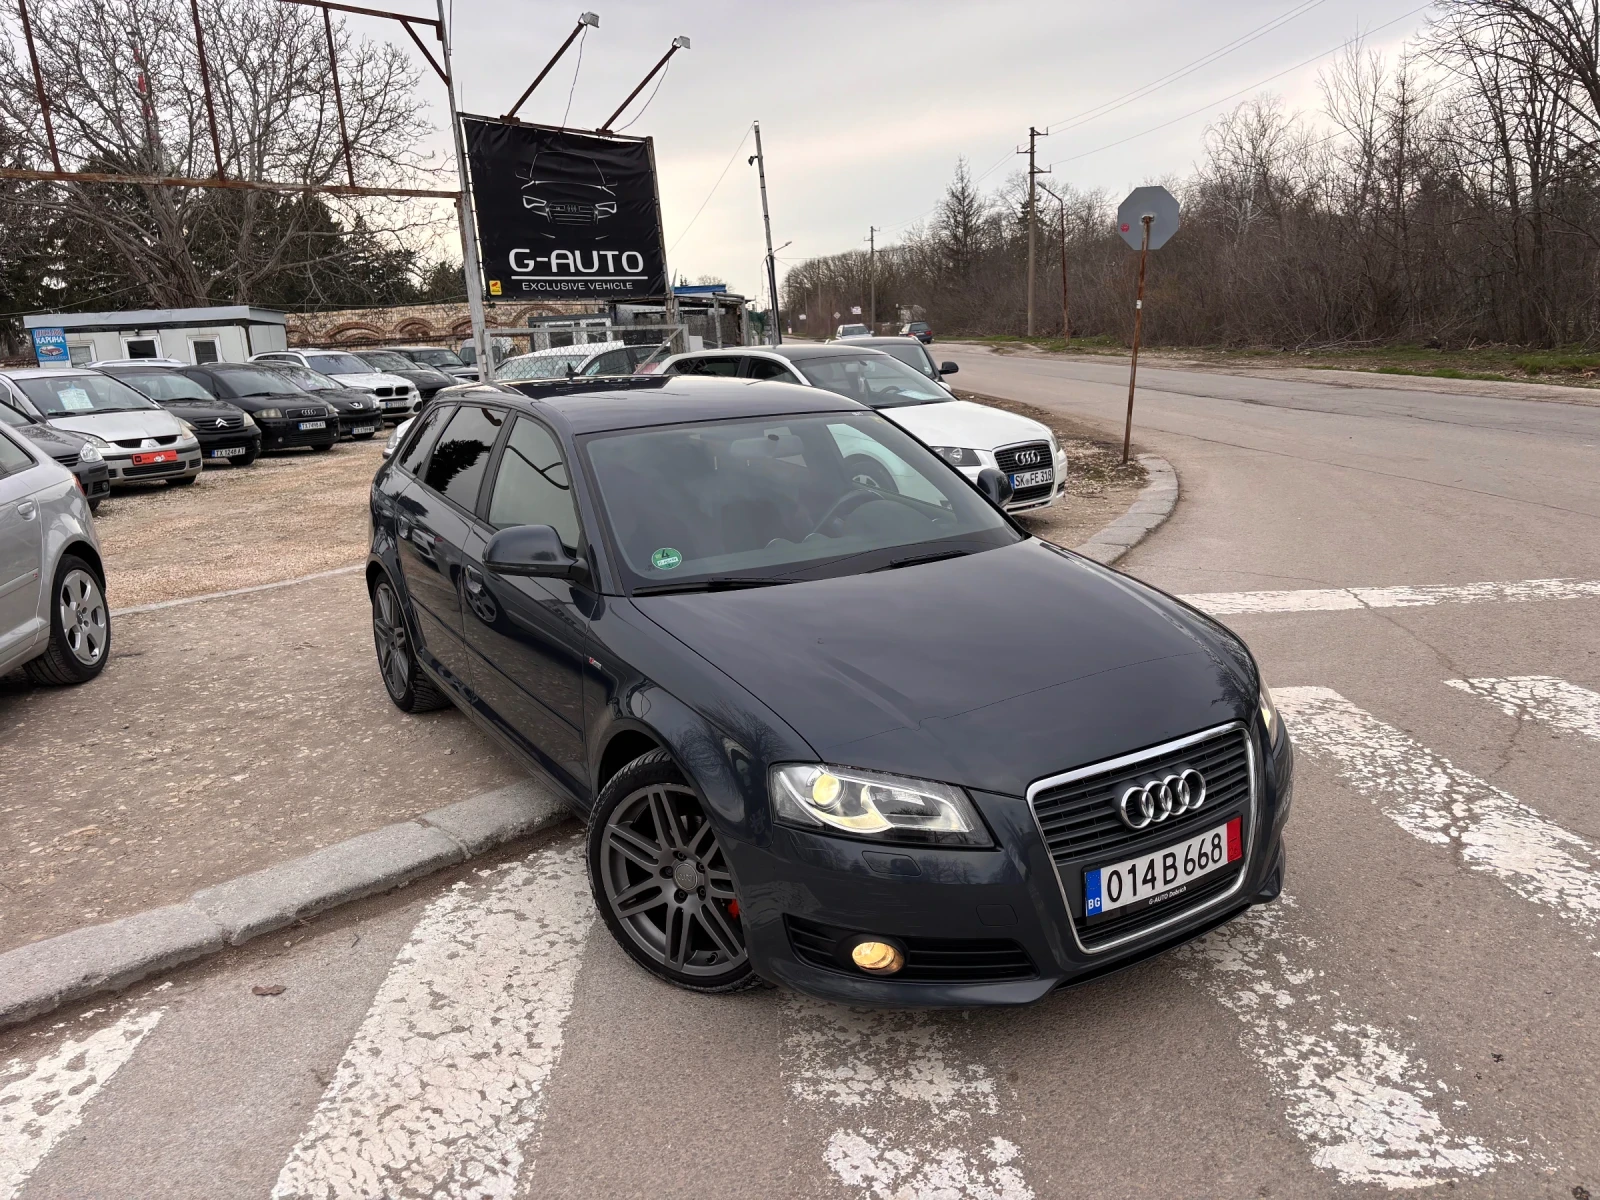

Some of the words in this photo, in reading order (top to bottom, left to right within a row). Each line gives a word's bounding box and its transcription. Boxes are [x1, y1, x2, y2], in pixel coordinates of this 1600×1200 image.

[509, 248, 644, 272] G-AUTO
[522, 282, 586, 291] EXCLUSIVE
[588, 281, 633, 290] VEHICLE
[1015, 475, 1025, 487] SK
[1030, 472, 1039, 484] FE
[1040, 469, 1052, 482] 318
[662, 549, 670, 558] 4
[1088, 897, 1101, 909] BG
[1149, 893, 1168, 905] G-AUTO
[1169, 886, 1187, 897] Dobrich
